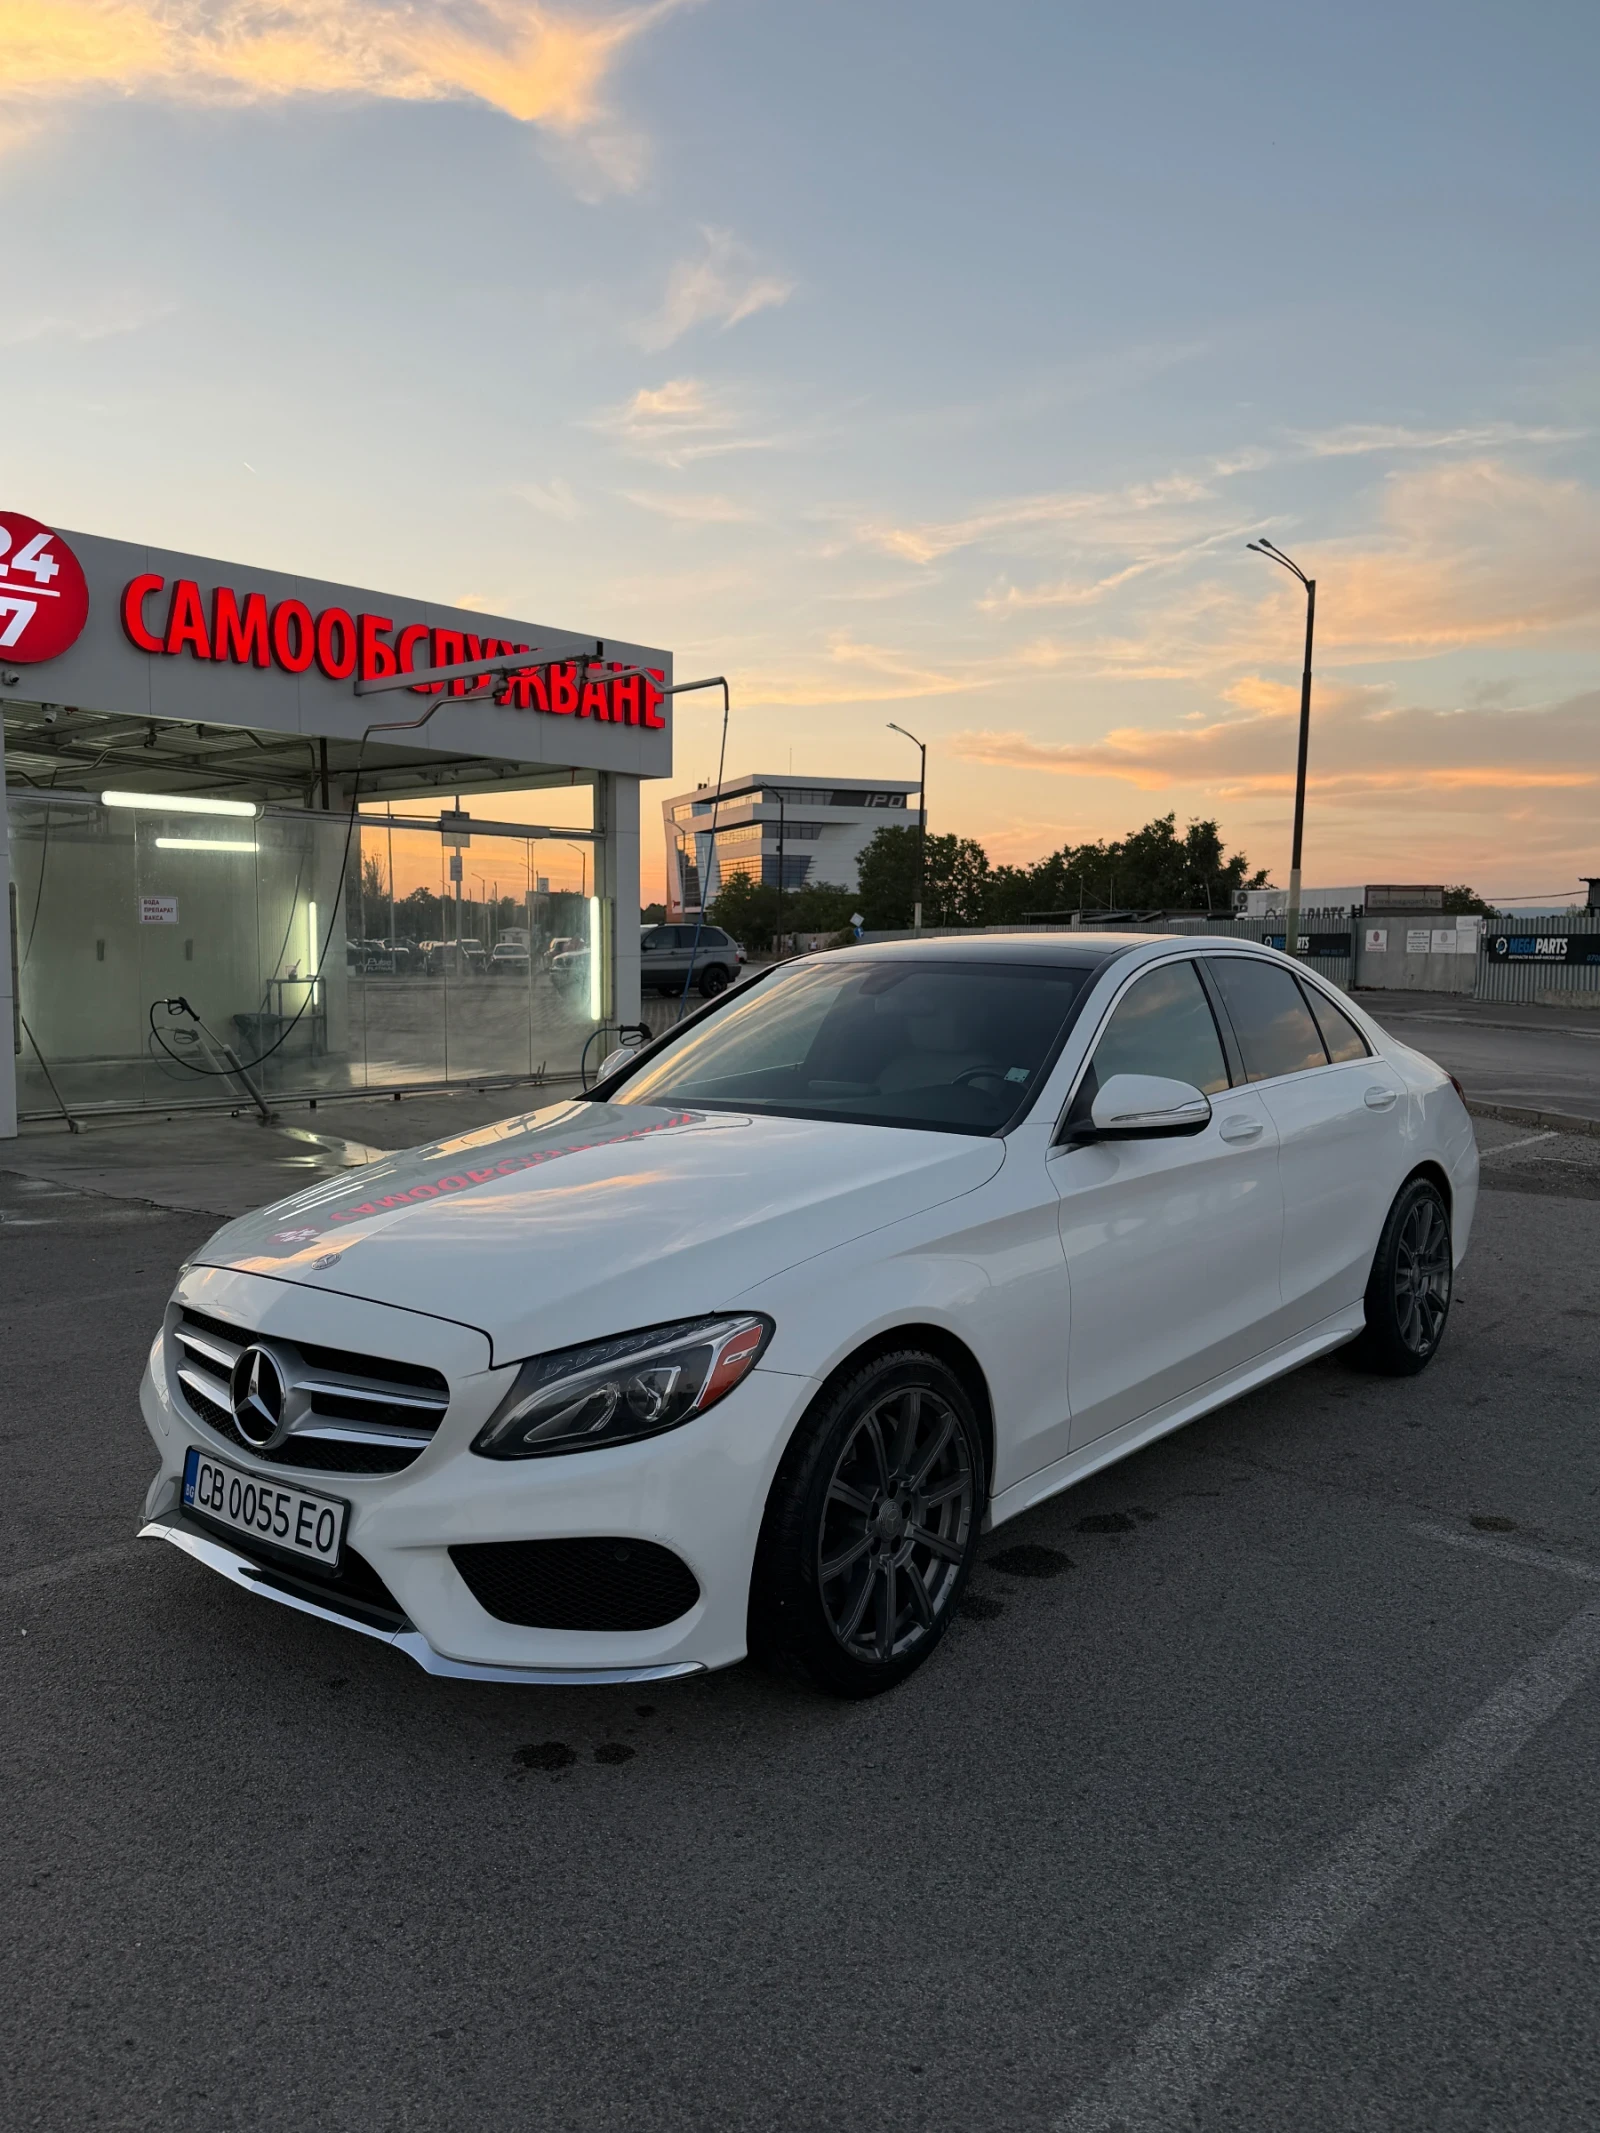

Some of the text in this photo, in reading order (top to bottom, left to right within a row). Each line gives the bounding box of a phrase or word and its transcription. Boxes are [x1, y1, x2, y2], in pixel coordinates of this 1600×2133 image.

[0, 596, 38, 647] 7
[864, 794, 905, 808] IPO
[1508, 938, 1568, 955] MEGAPARTS
[186, 1483, 195, 1499] BG
[198, 1463, 335, 1553] CB 0055 EO
